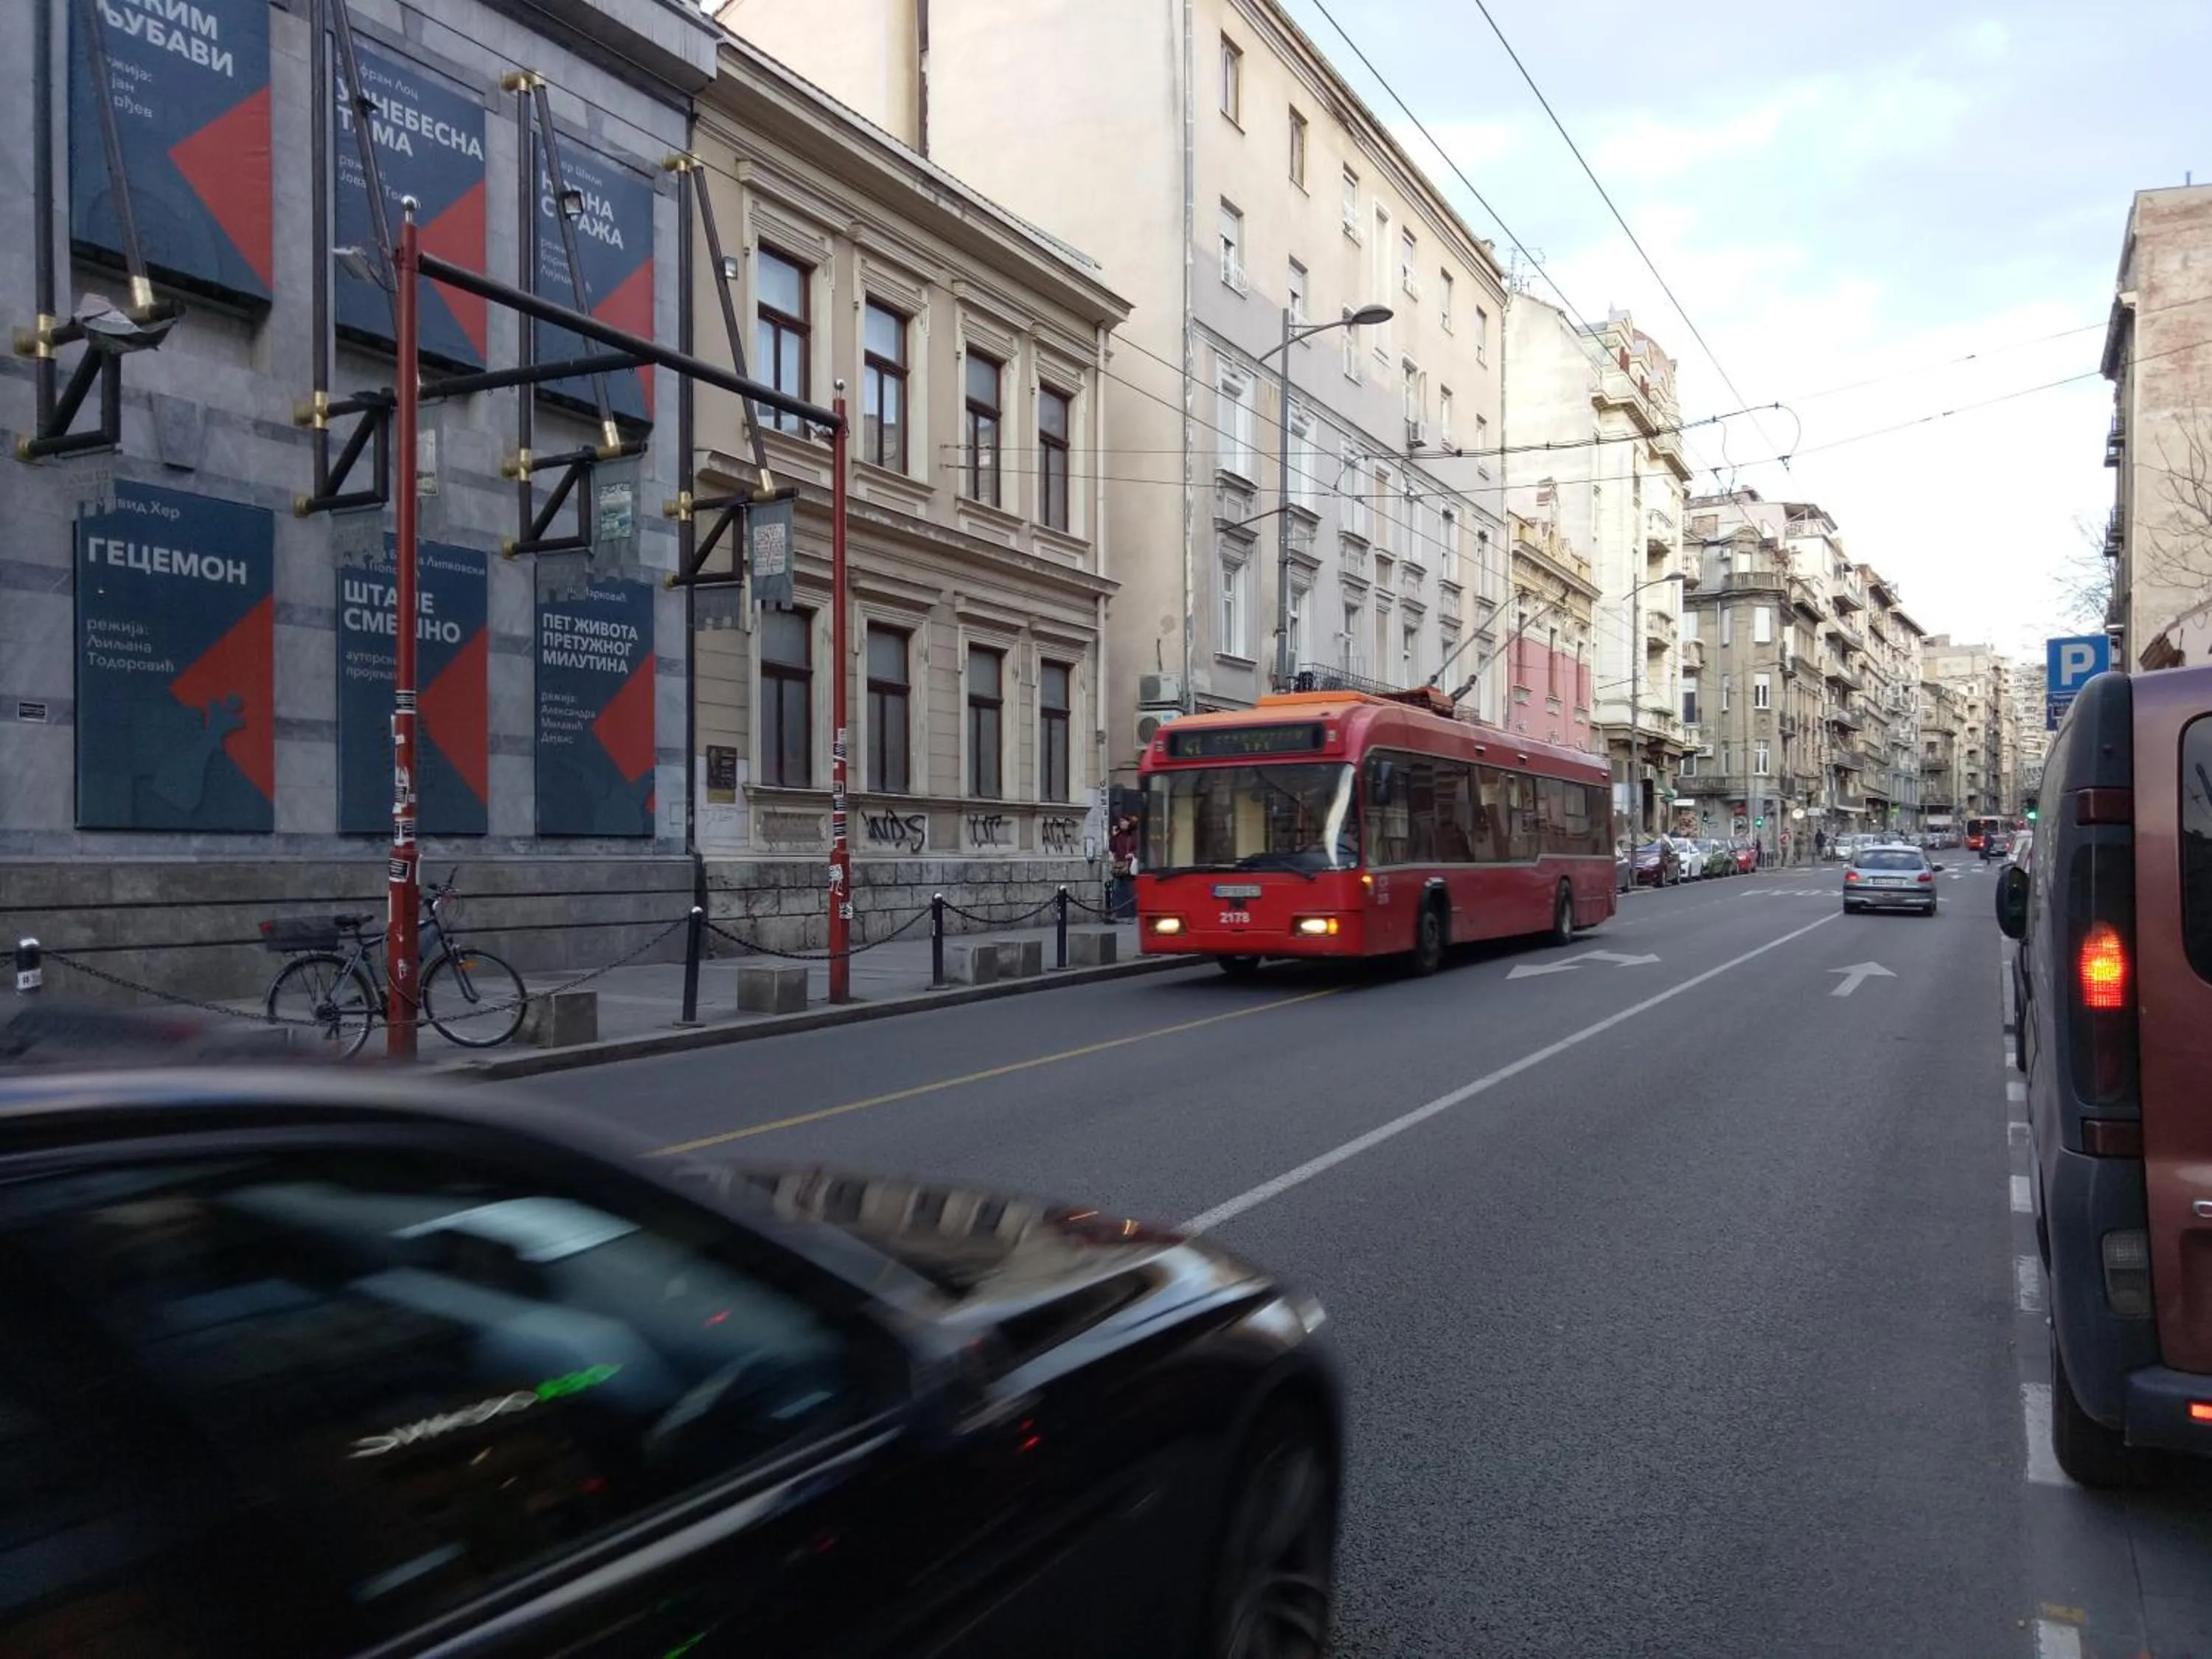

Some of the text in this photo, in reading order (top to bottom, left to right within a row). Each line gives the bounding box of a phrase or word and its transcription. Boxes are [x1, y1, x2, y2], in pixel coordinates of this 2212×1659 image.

[336, 105, 414, 158] ТМА
[540, 195, 625, 251] САЖА
[150, 501, 180, 521] Хер
[87, 537, 247, 585] ГЕЦЕМОН
[344, 579, 398, 608] ШТА
[542, 613, 639, 641] ПЕТ ЖИВОТА
[542, 631, 633, 657] ПРЕТУЖНОГ
[542, 649, 629, 674] МИЛУТИНА
[2061, 643, 2096, 686] P
